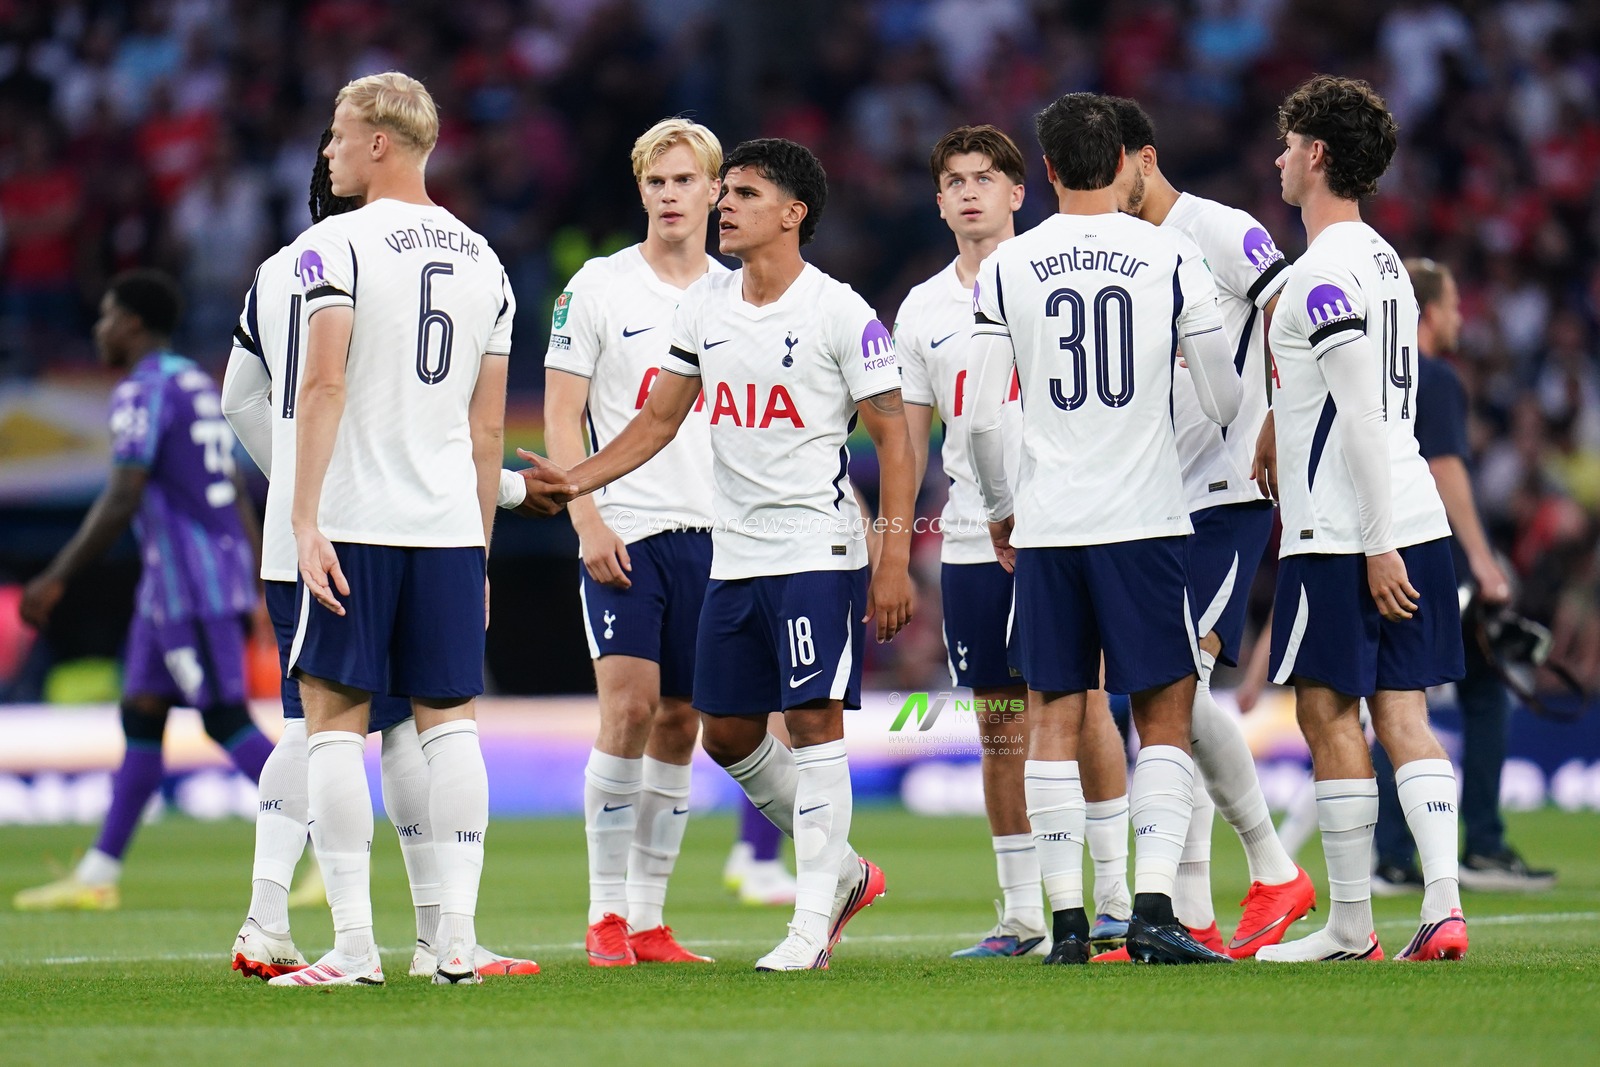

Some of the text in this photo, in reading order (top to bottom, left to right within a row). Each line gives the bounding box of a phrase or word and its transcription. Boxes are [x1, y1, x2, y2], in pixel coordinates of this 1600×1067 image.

[385, 223, 479, 263] van hecke
[1029, 246, 1149, 283] bentancur
[1373, 252, 1399, 280] gray
[416, 261, 454, 385] 6
[282, 294, 302, 419] 1
[1045, 285, 1135, 411] 30
[1382, 298, 1412, 422] 14
[710, 381, 805, 429] AIA
[787, 616, 816, 668] 18
[259, 799, 283, 811] THFC
[396, 823, 423, 837] THFC
[455, 830, 483, 843] THFC
